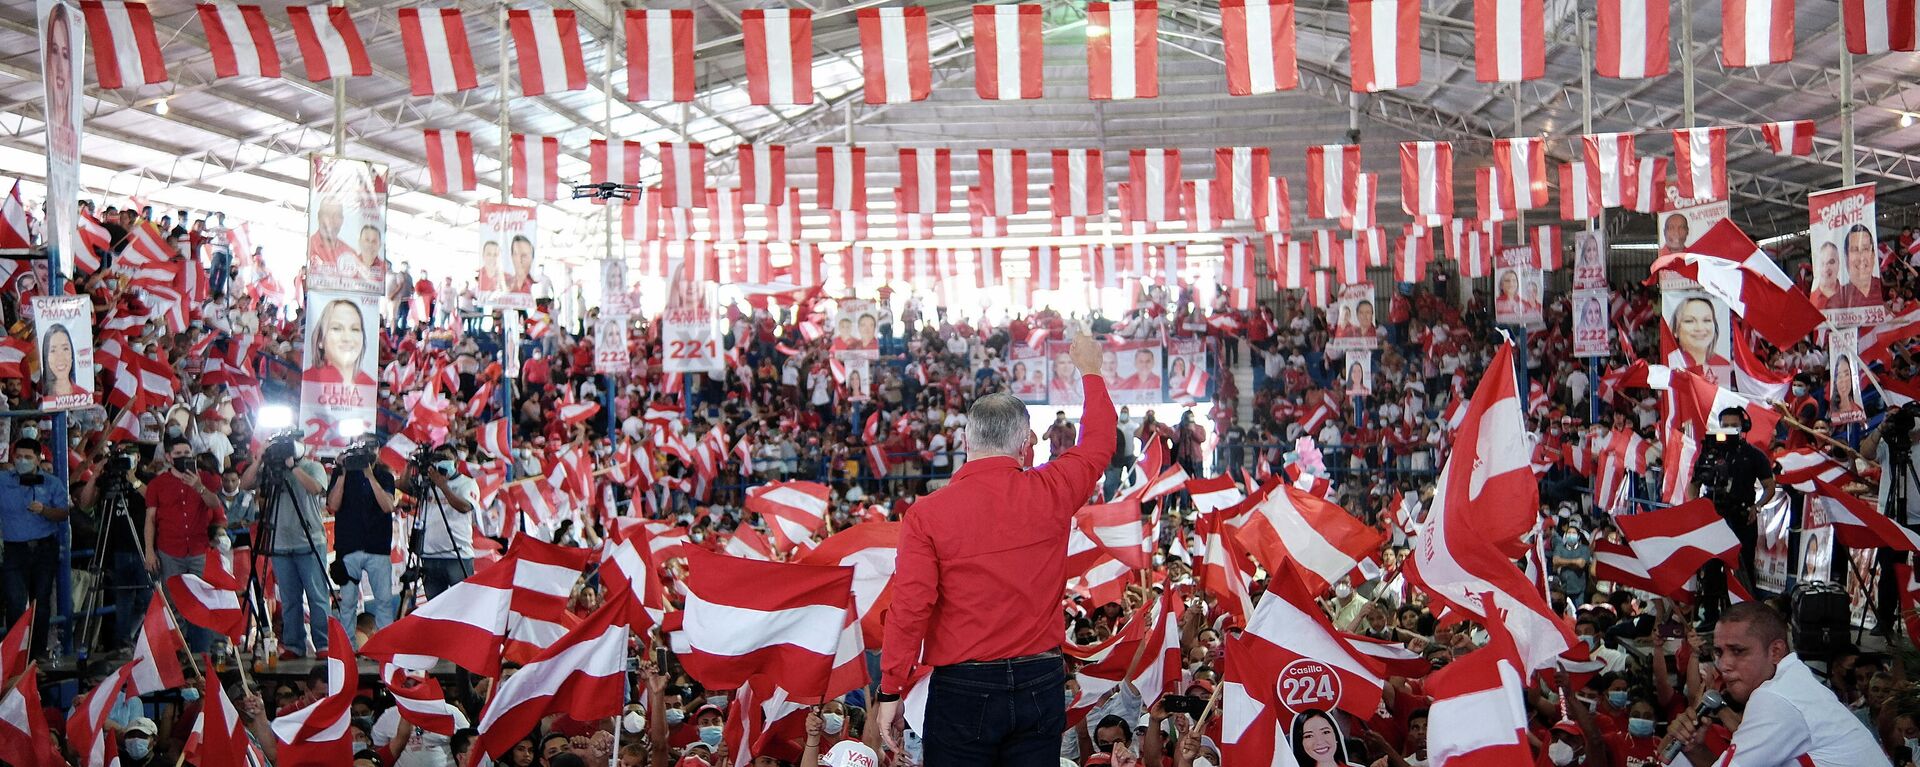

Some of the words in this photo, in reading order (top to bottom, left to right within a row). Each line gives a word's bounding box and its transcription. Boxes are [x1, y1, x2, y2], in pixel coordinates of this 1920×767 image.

[1579, 267, 1603, 279] 222
[41, 308, 81, 319] AMAYA
[1580, 329, 1606, 340] 222
[670, 340, 716, 359] 221
[601, 351, 626, 362] 222
[74, 393, 94, 406] 224
[1289, 665, 1323, 675] Casilla
[1283, 674, 1335, 705] 224
